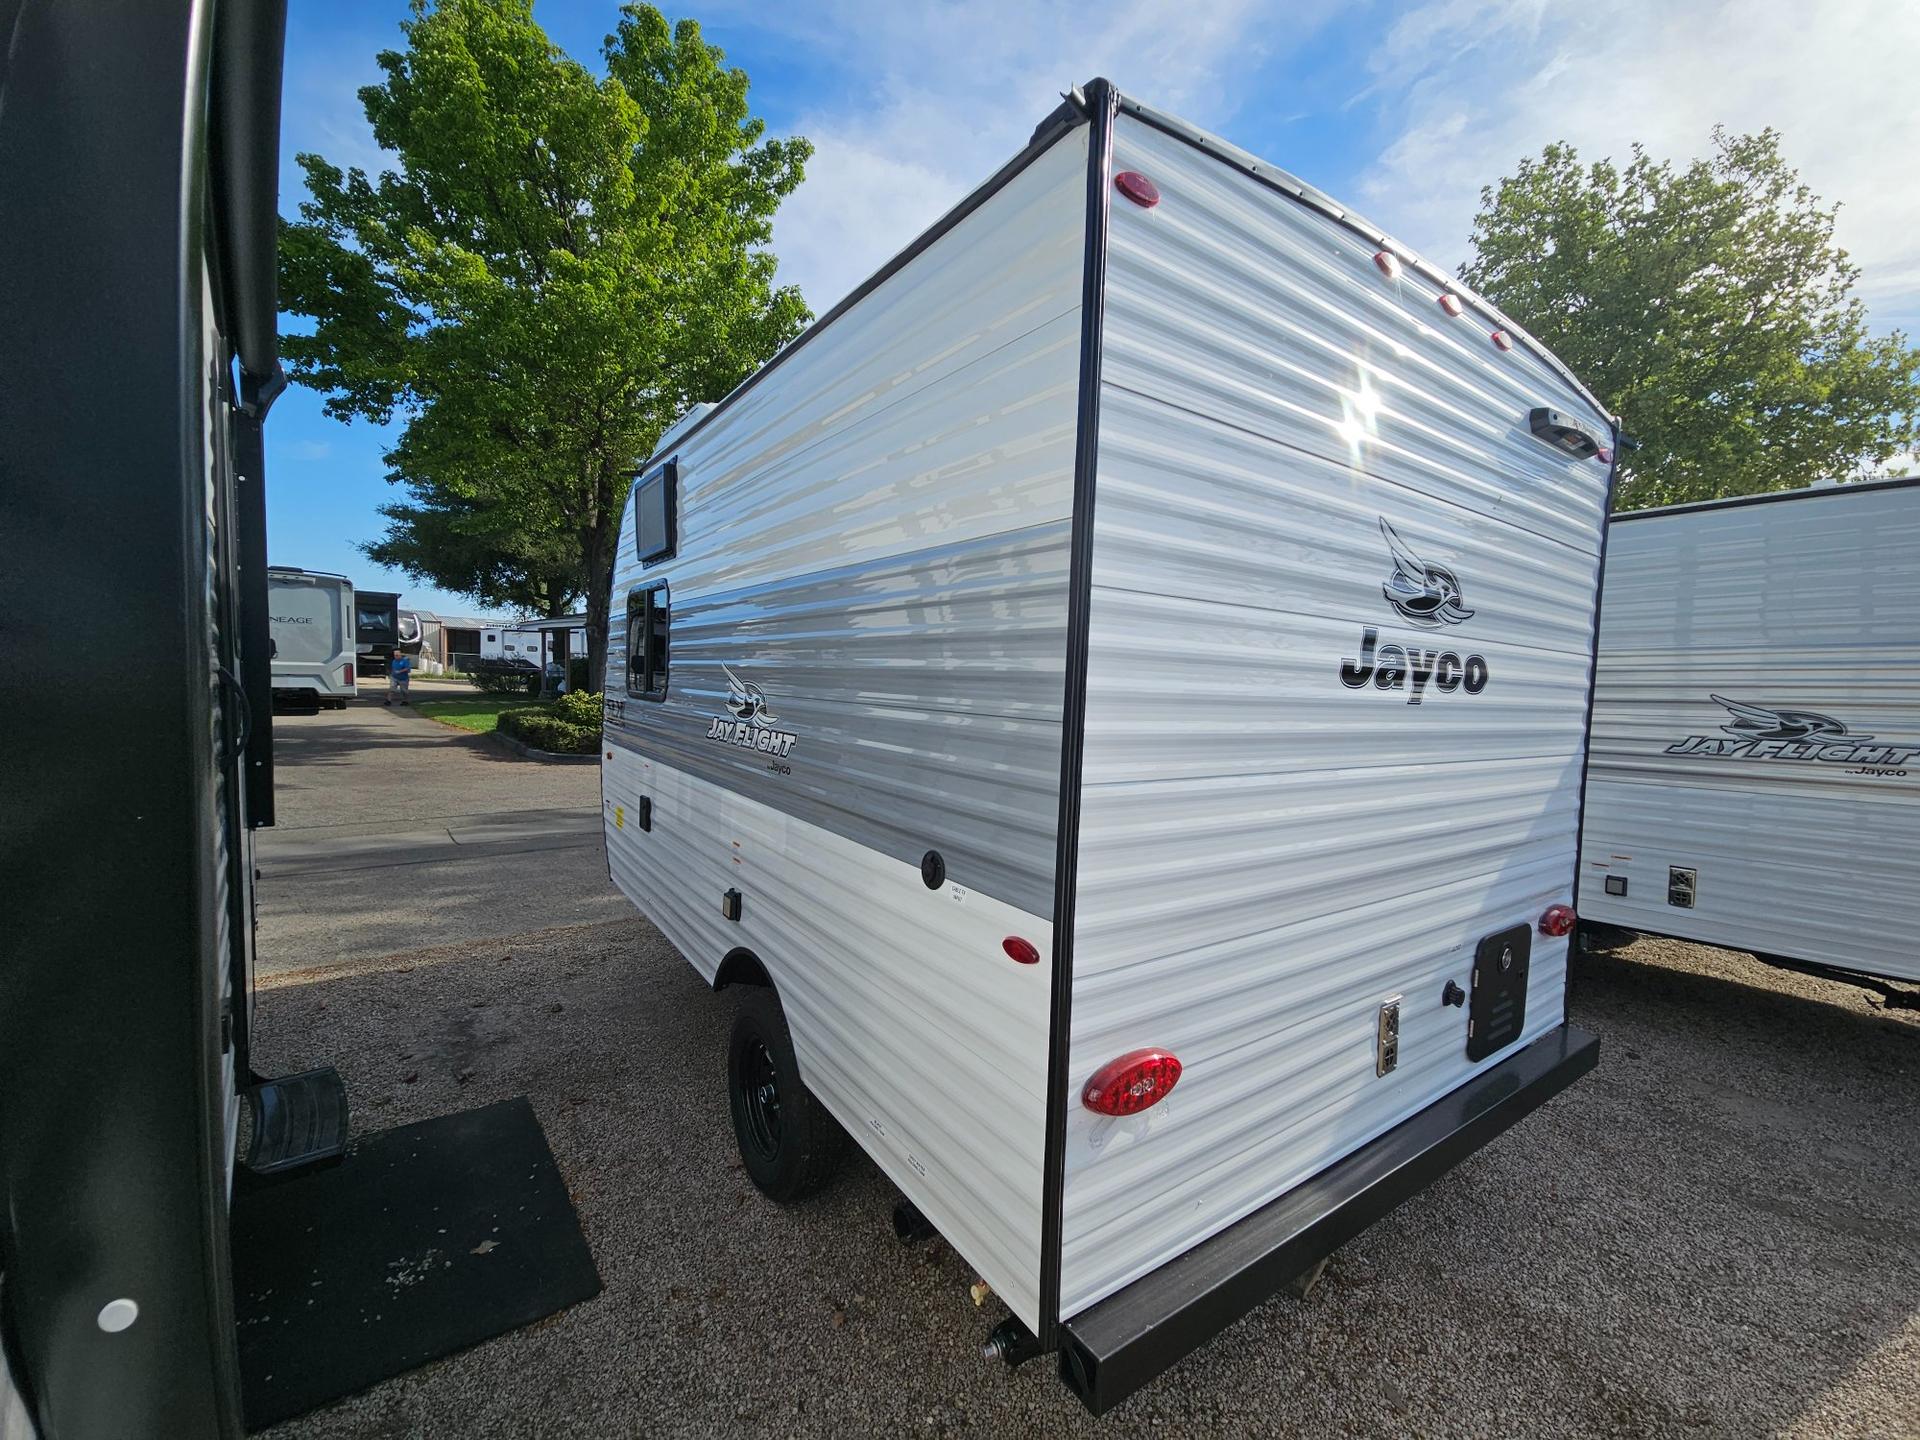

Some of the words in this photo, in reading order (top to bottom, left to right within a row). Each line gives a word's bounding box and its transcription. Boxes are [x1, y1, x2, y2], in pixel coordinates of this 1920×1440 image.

[269, 616, 313, 625] NEAGE
[1339, 626, 1489, 705] Jayco
[770, 761, 791, 776] Jayco
[1855, 767, 1907, 777] Jayco
